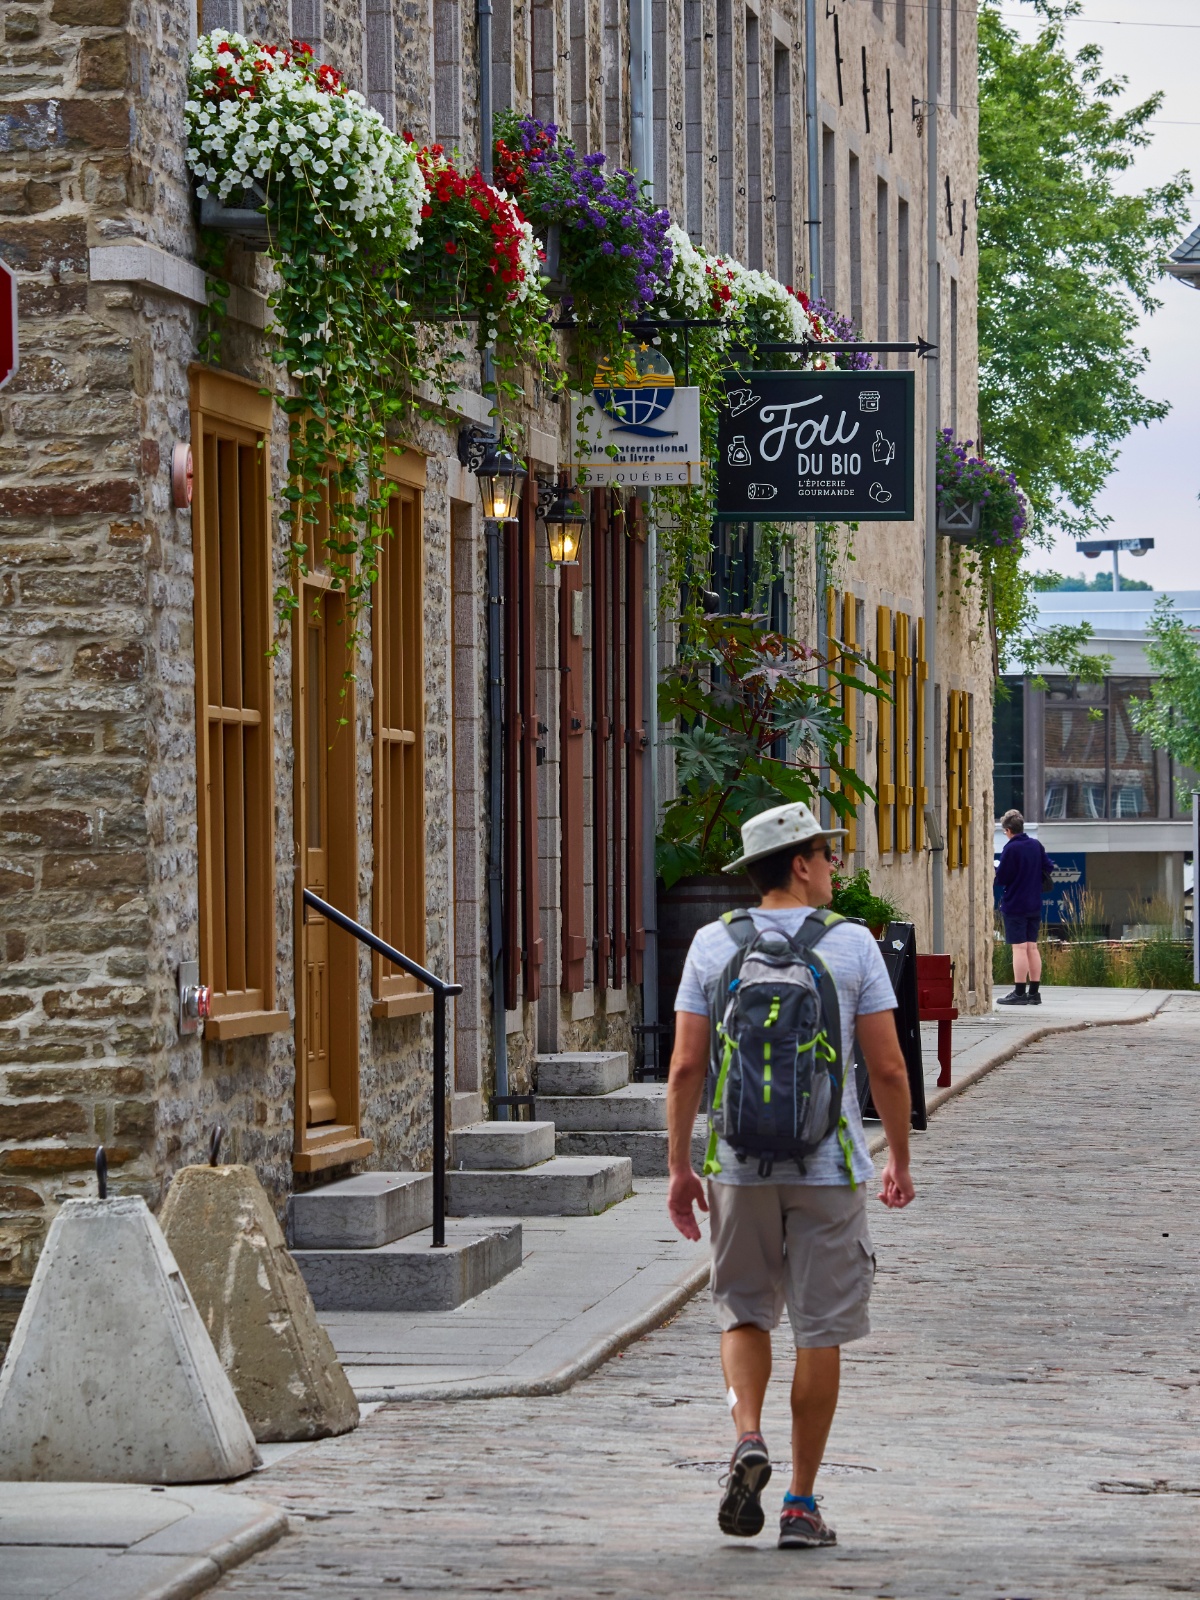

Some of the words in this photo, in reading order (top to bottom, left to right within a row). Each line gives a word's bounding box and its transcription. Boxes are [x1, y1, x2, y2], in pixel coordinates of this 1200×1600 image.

[759, 394, 860, 462] Fou
[615, 444, 688, 453] nternational
[613, 454, 626, 462] du
[630, 453, 656, 462] livre
[798, 453, 823, 475] DU
[831, 453, 862, 475] BIO
[585, 473, 605, 482] DE
[616, 470, 687, 482] QUÉBEC
[798, 478, 846, 487] L'ÉPICERIE
